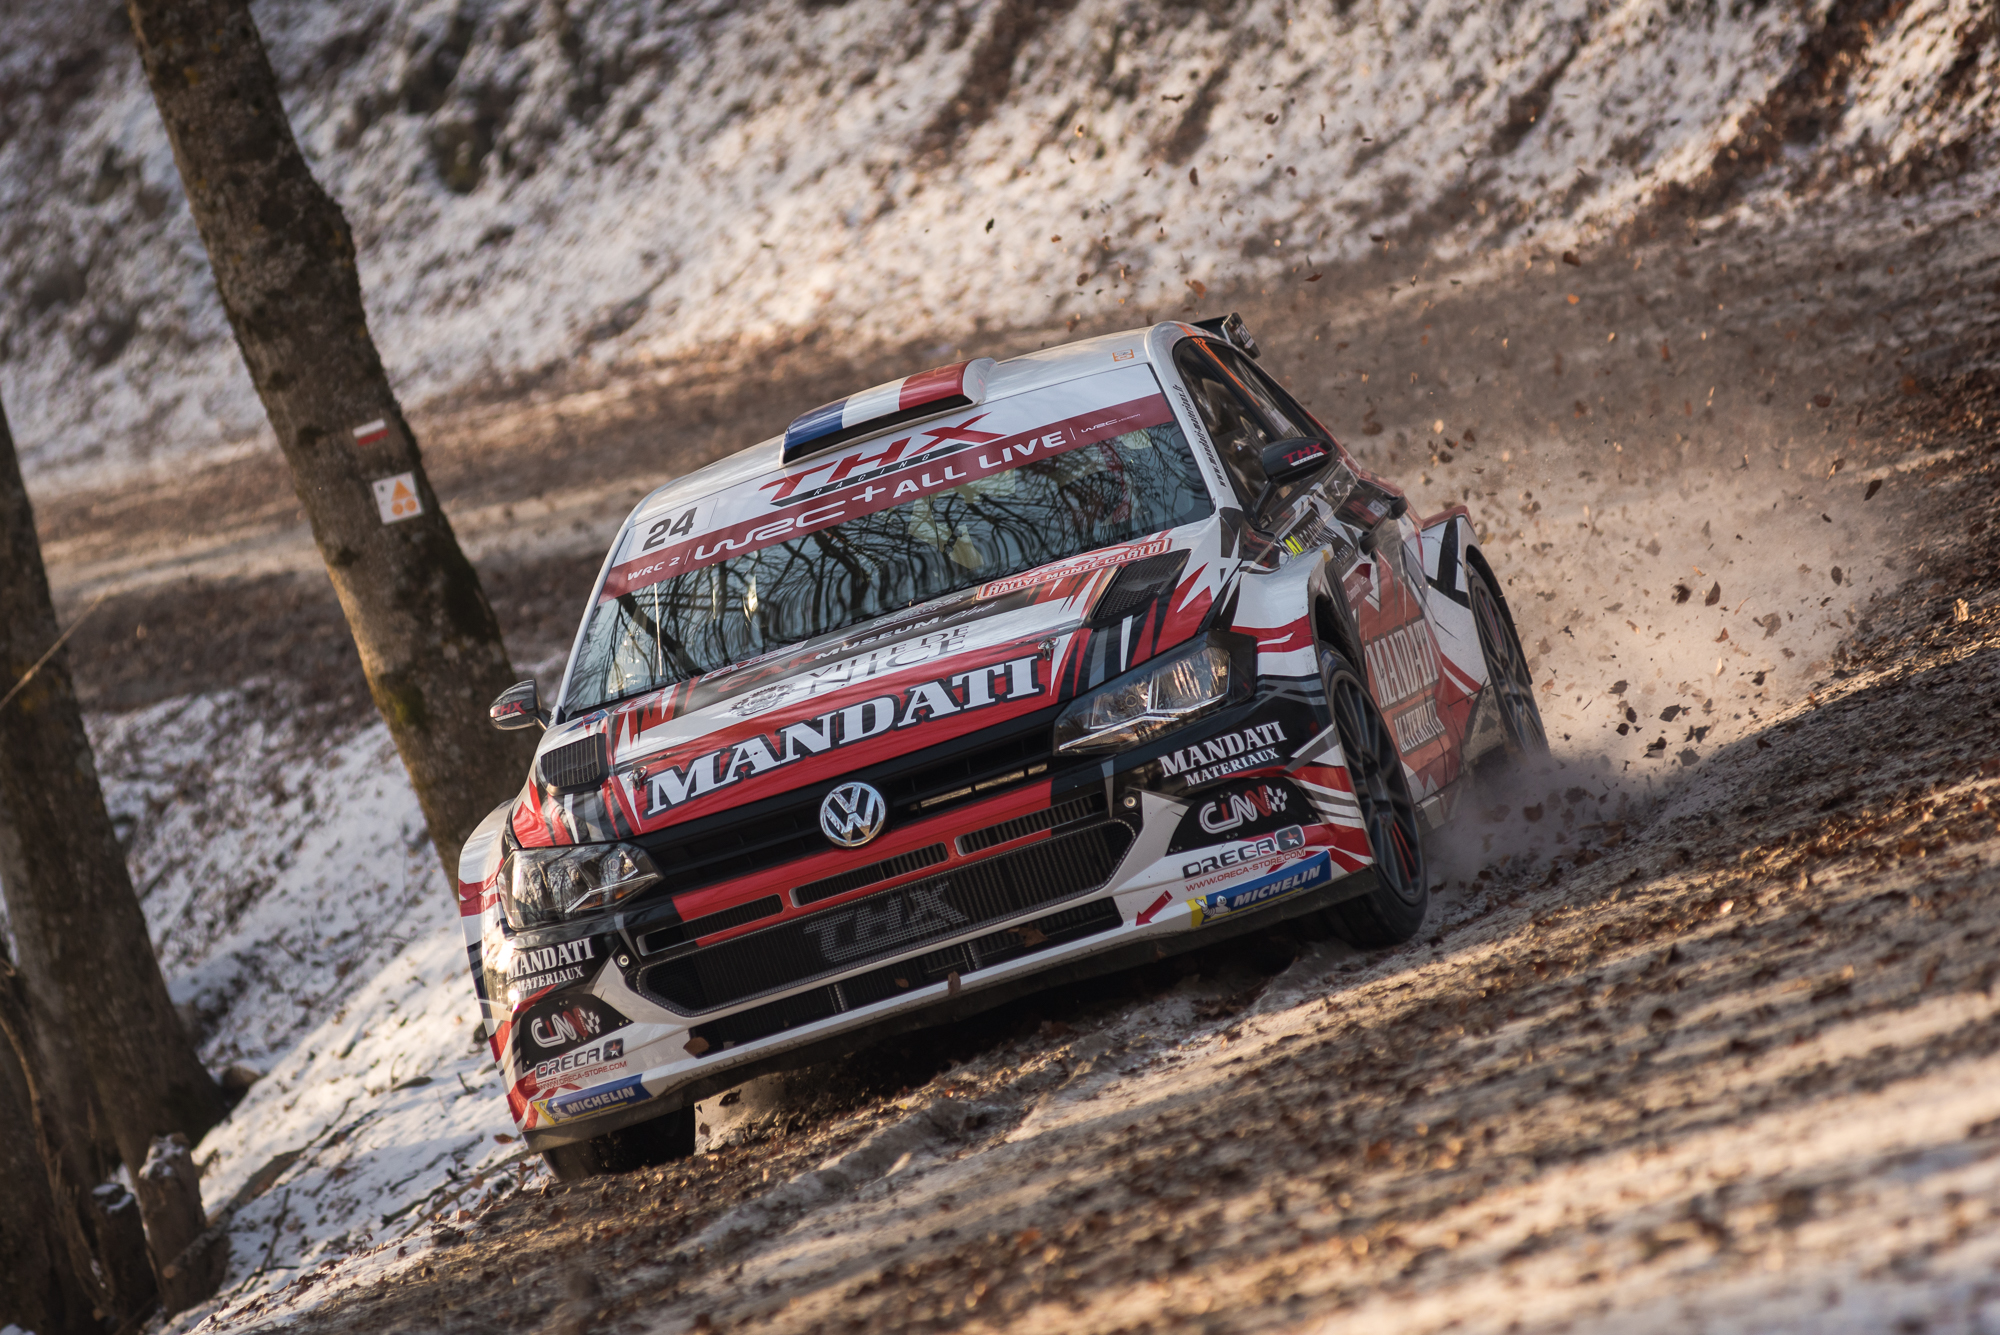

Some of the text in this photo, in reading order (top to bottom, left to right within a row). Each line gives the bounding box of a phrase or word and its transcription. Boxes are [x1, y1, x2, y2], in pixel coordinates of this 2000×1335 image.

[758, 411, 1007, 501] THX
[814, 453, 930, 496] RACING
[1282, 442, 1328, 464] THX
[694, 500, 846, 560] WRC
[893, 465, 967, 498] ALL
[978, 430, 1067, 469] LIVE
[641, 507, 698, 551] 24
[627, 557, 679, 581] WRC 2
[988, 576, 1042, 597] RALLYE
[921, 625, 970, 649] DE
[645, 654, 1041, 816] MANDATI
[1157, 721, 1288, 778] MANDATI
[1185, 747, 1280, 787] MATERIAUX
[1182, 837, 1276, 879] ORECA
[1185, 849, 1306, 892] WWW.ORECA-STORE.COM
[1233, 865, 1320, 908] MICHELIN
[803, 880, 969, 953] THX
[506, 937, 595, 981] MANDATI
[516, 966, 585, 993] MATERIAUX
[535, 1047, 600, 1079] ORECA
[566, 1086, 636, 1114] MICHELIN
